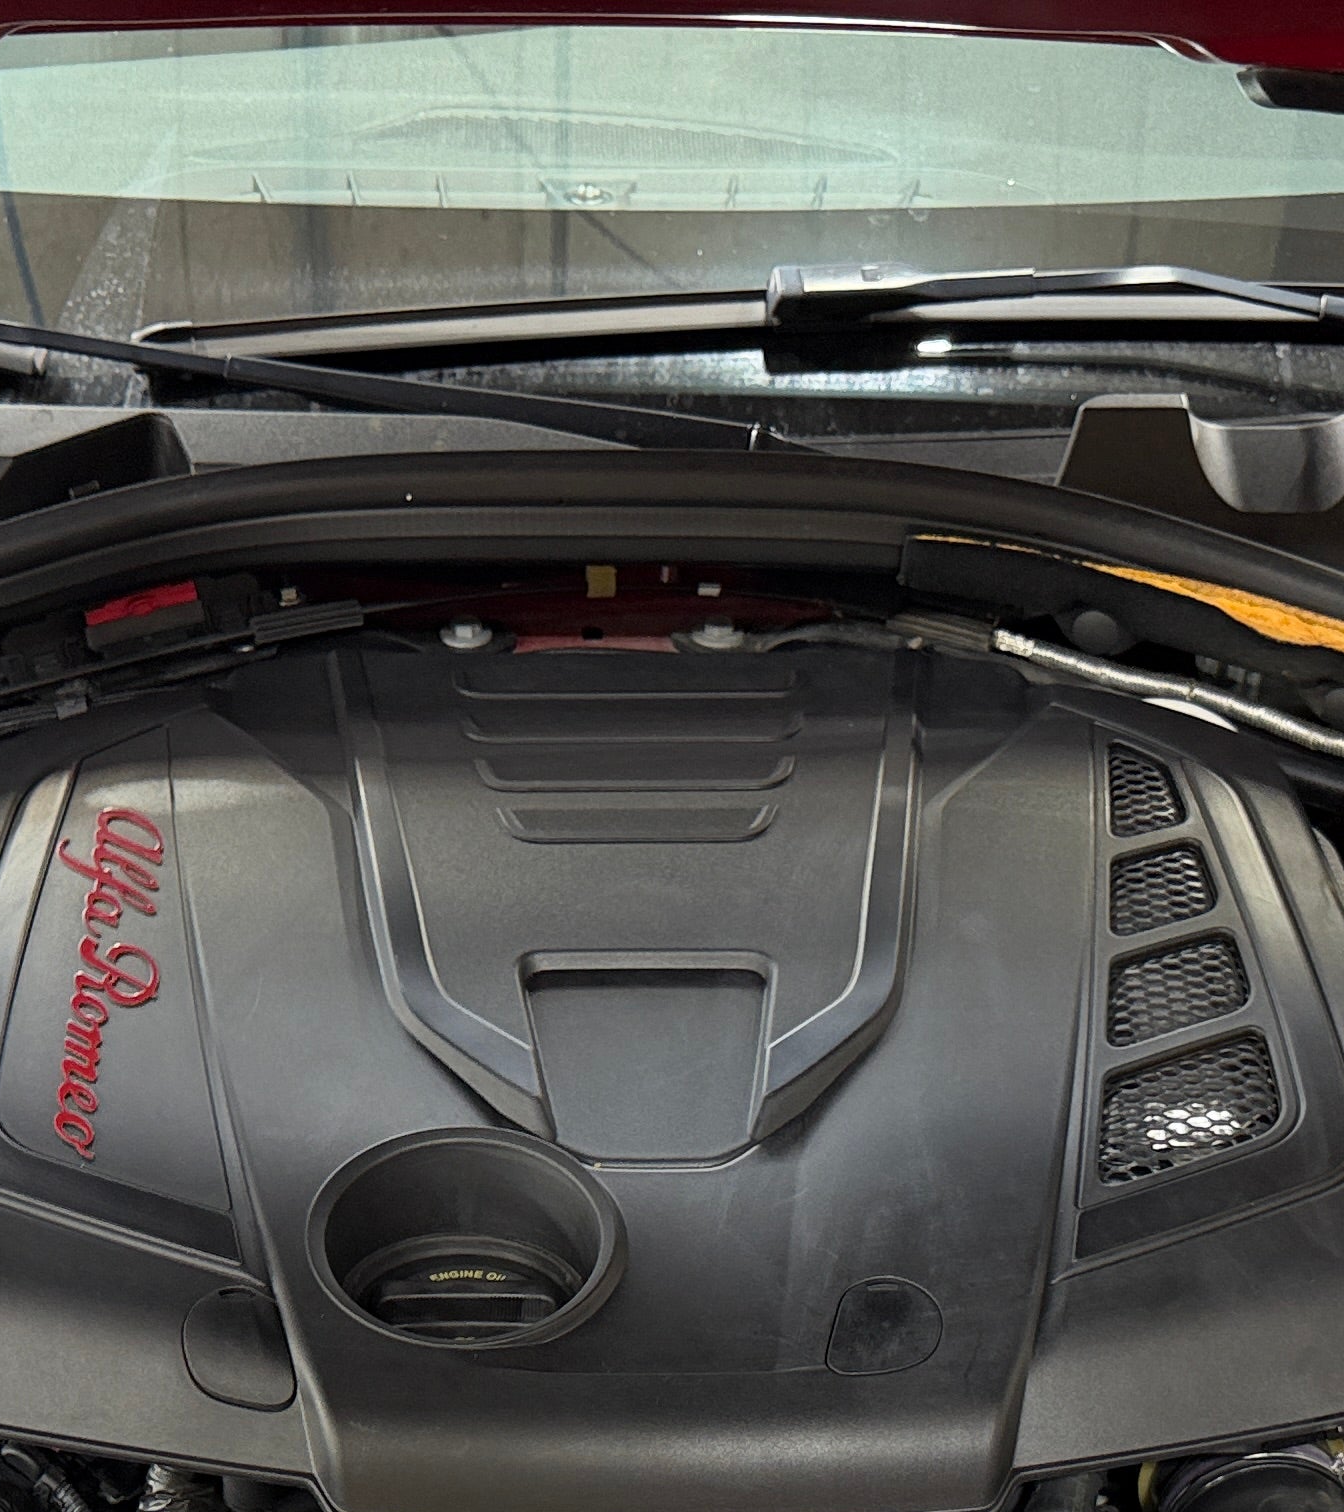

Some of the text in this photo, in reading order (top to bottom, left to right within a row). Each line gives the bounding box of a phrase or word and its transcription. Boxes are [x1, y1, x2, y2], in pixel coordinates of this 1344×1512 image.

[53, 807, 165, 1161] Alfa Romeo
[428, 1269, 484, 1282] ENGINE
